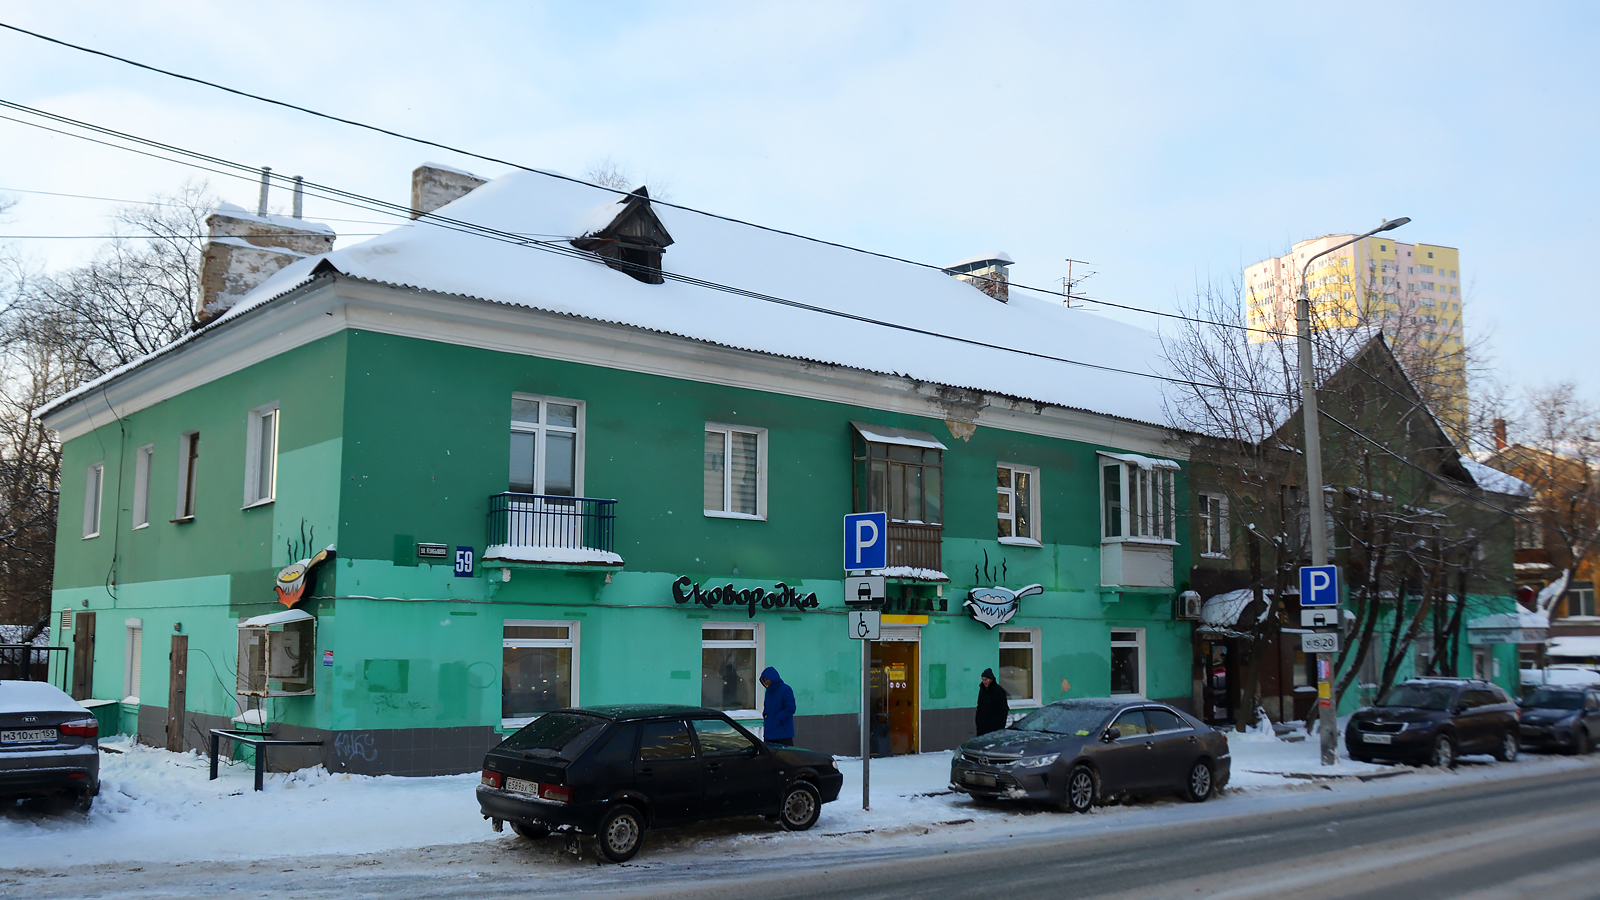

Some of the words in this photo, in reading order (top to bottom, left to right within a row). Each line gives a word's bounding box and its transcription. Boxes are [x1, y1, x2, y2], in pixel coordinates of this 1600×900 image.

[856, 519, 879, 563] P
[456, 551, 472, 572] 59
[672, 575, 820, 618] Сковородка
[1310, 570, 1330, 601] P
[1322, 638, 1334, 647] 20
[41, 729, 55, 737] 159
